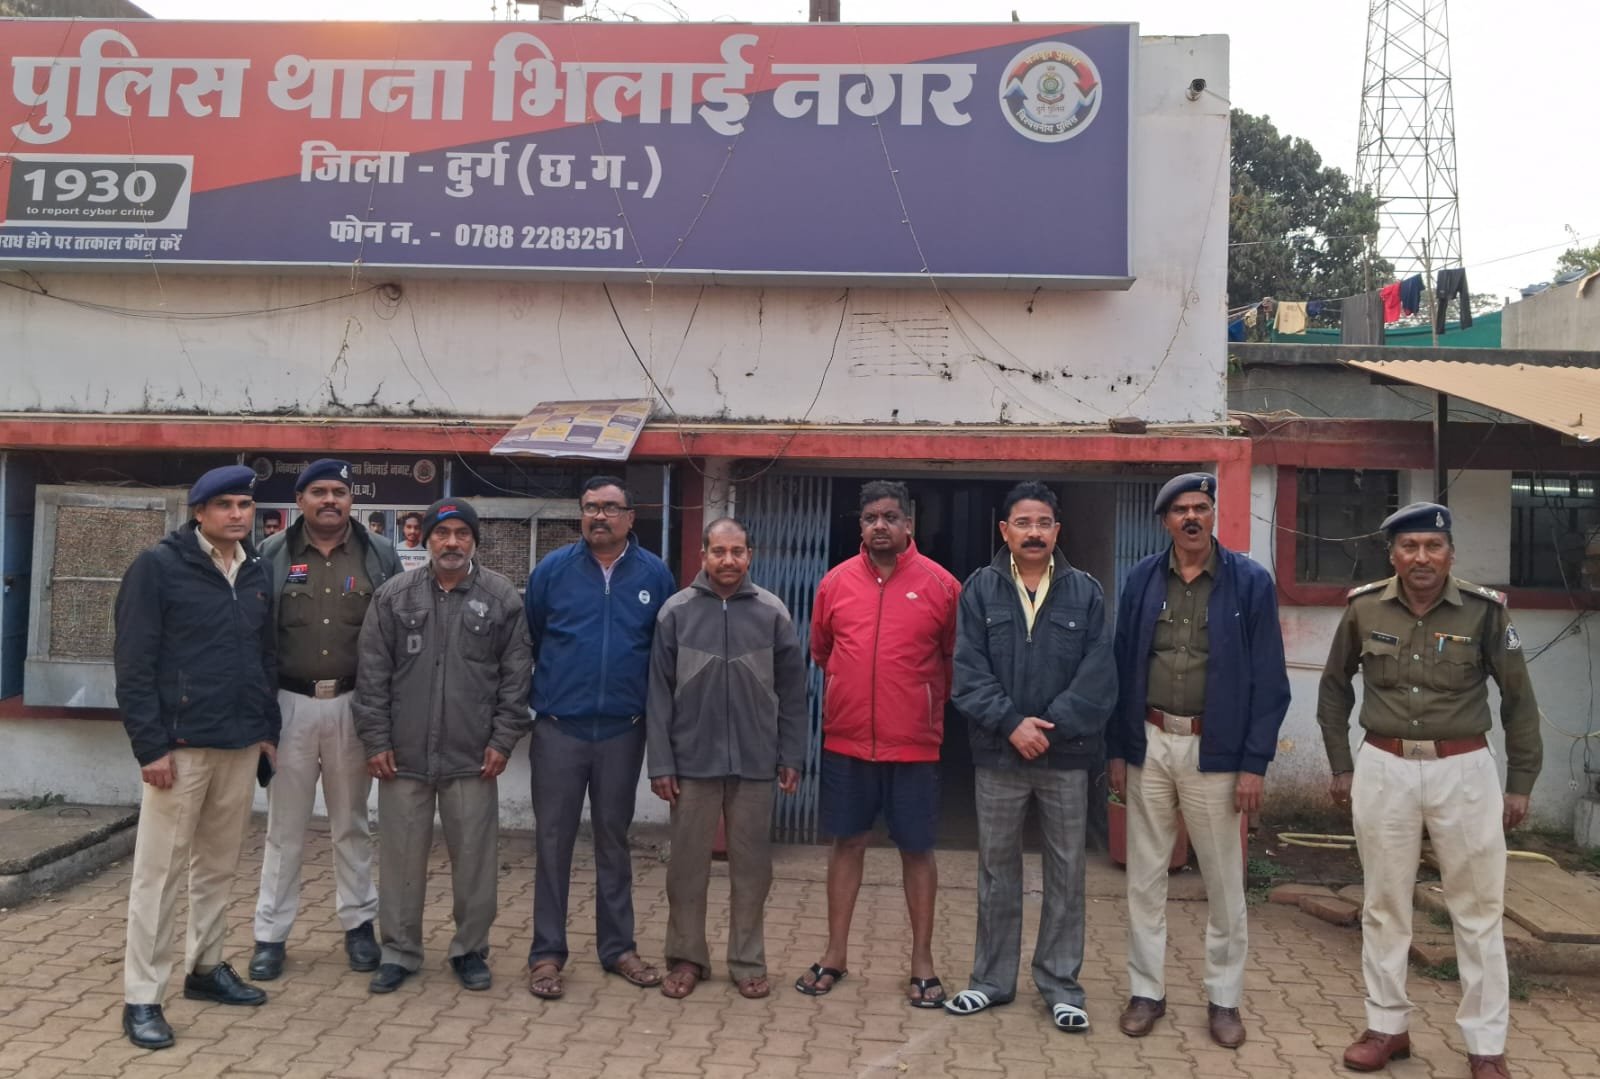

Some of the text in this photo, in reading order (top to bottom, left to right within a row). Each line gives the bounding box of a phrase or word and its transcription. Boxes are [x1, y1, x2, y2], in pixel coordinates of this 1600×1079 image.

[10, 28, 977, 145] पुलिस थाना भिलाई नगर
[23, 168, 157, 203] 1930
[300, 140, 663, 199] जिला - दुर्ग (छ.ग.)
[26, 206, 155, 217] to report cyber crime
[0, 231, 183, 251] राध होने पर तत्काल कॉल करें
[330, 215, 386, 244] फोन
[390, 221, 421, 246] न.
[455, 223, 514, 249] 0788
[521, 226, 625, 251] 2283251
